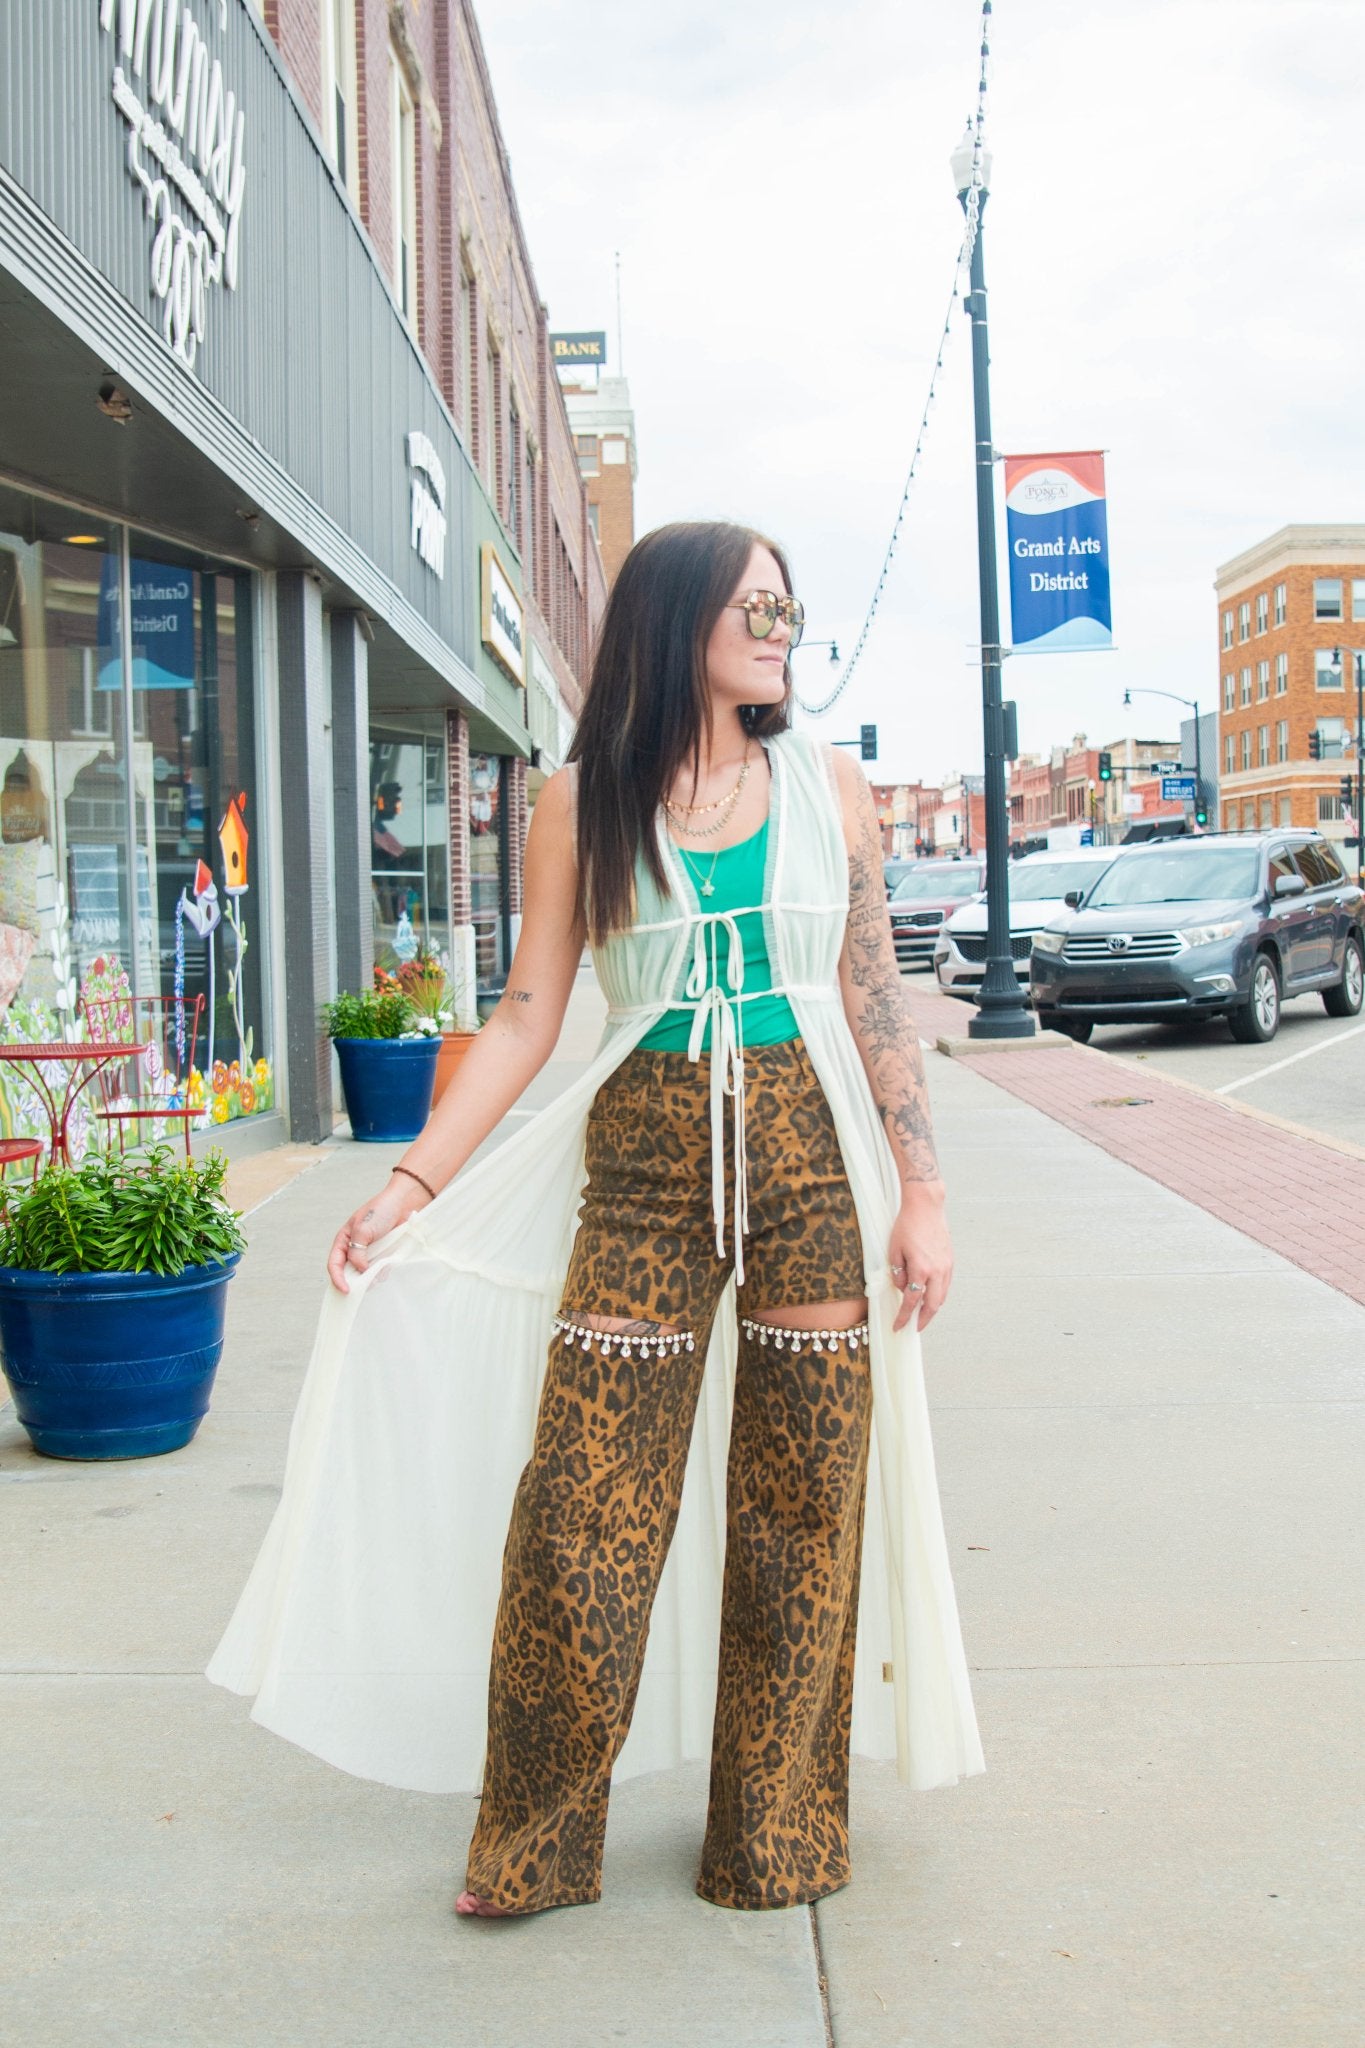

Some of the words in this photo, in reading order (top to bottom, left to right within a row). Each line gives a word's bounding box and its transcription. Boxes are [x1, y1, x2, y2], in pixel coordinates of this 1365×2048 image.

[555, 340, 600, 356] BANK
[1014, 536, 1064, 558] Grand
[1068, 536, 1101, 555] Arts
[1030, 571, 1088, 592] District
